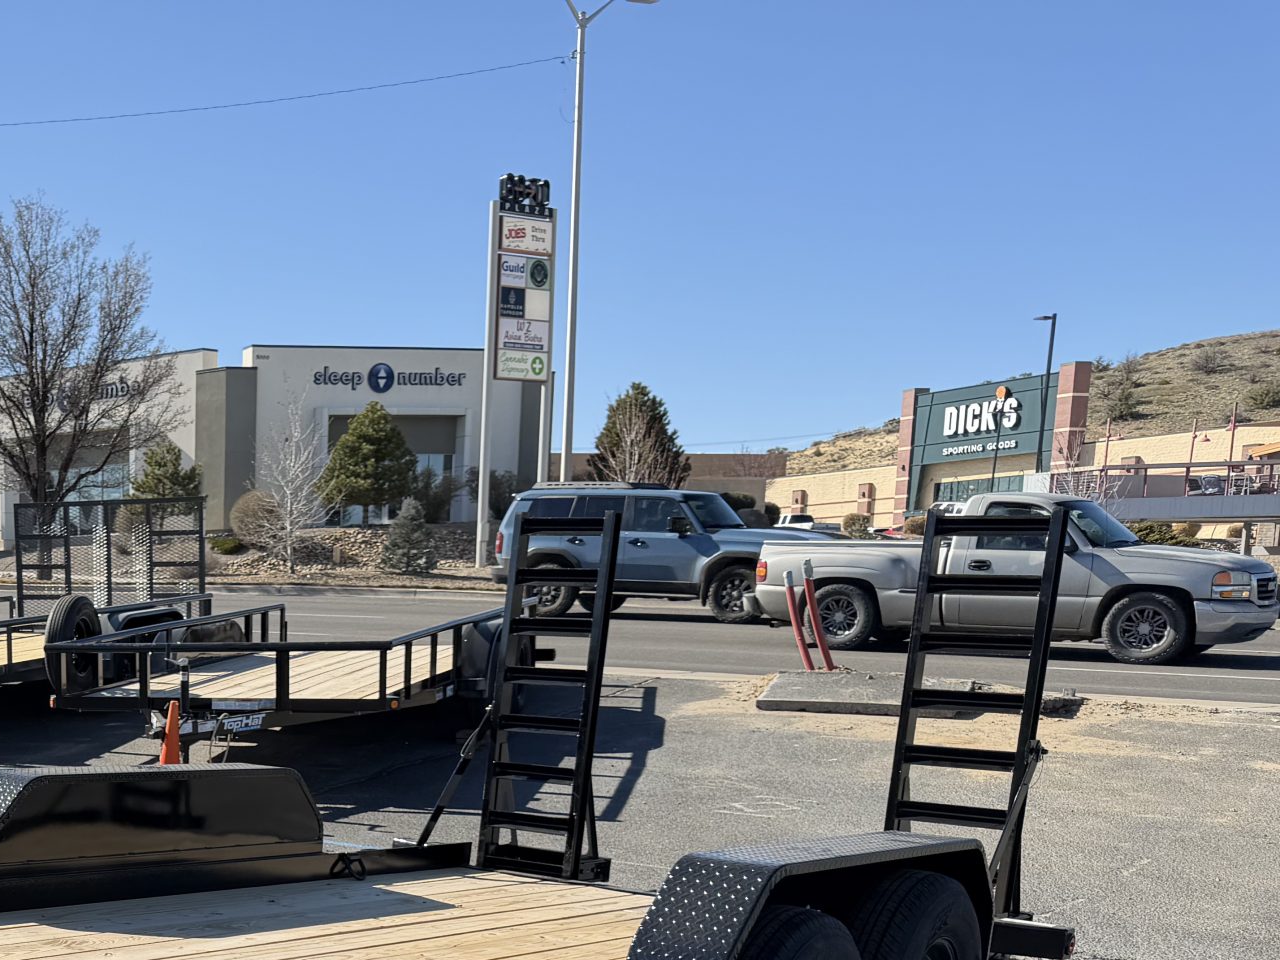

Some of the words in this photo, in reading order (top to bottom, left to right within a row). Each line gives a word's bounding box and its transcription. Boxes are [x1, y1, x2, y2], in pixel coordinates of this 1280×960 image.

[504, 203, 550, 216] PLAZA
[502, 261, 525, 274] Guild
[313, 366, 364, 391] sleep
[397, 367, 467, 387] number
[943, 394, 1018, 436] DICK'S
[942, 443, 983, 456] SPORTING
